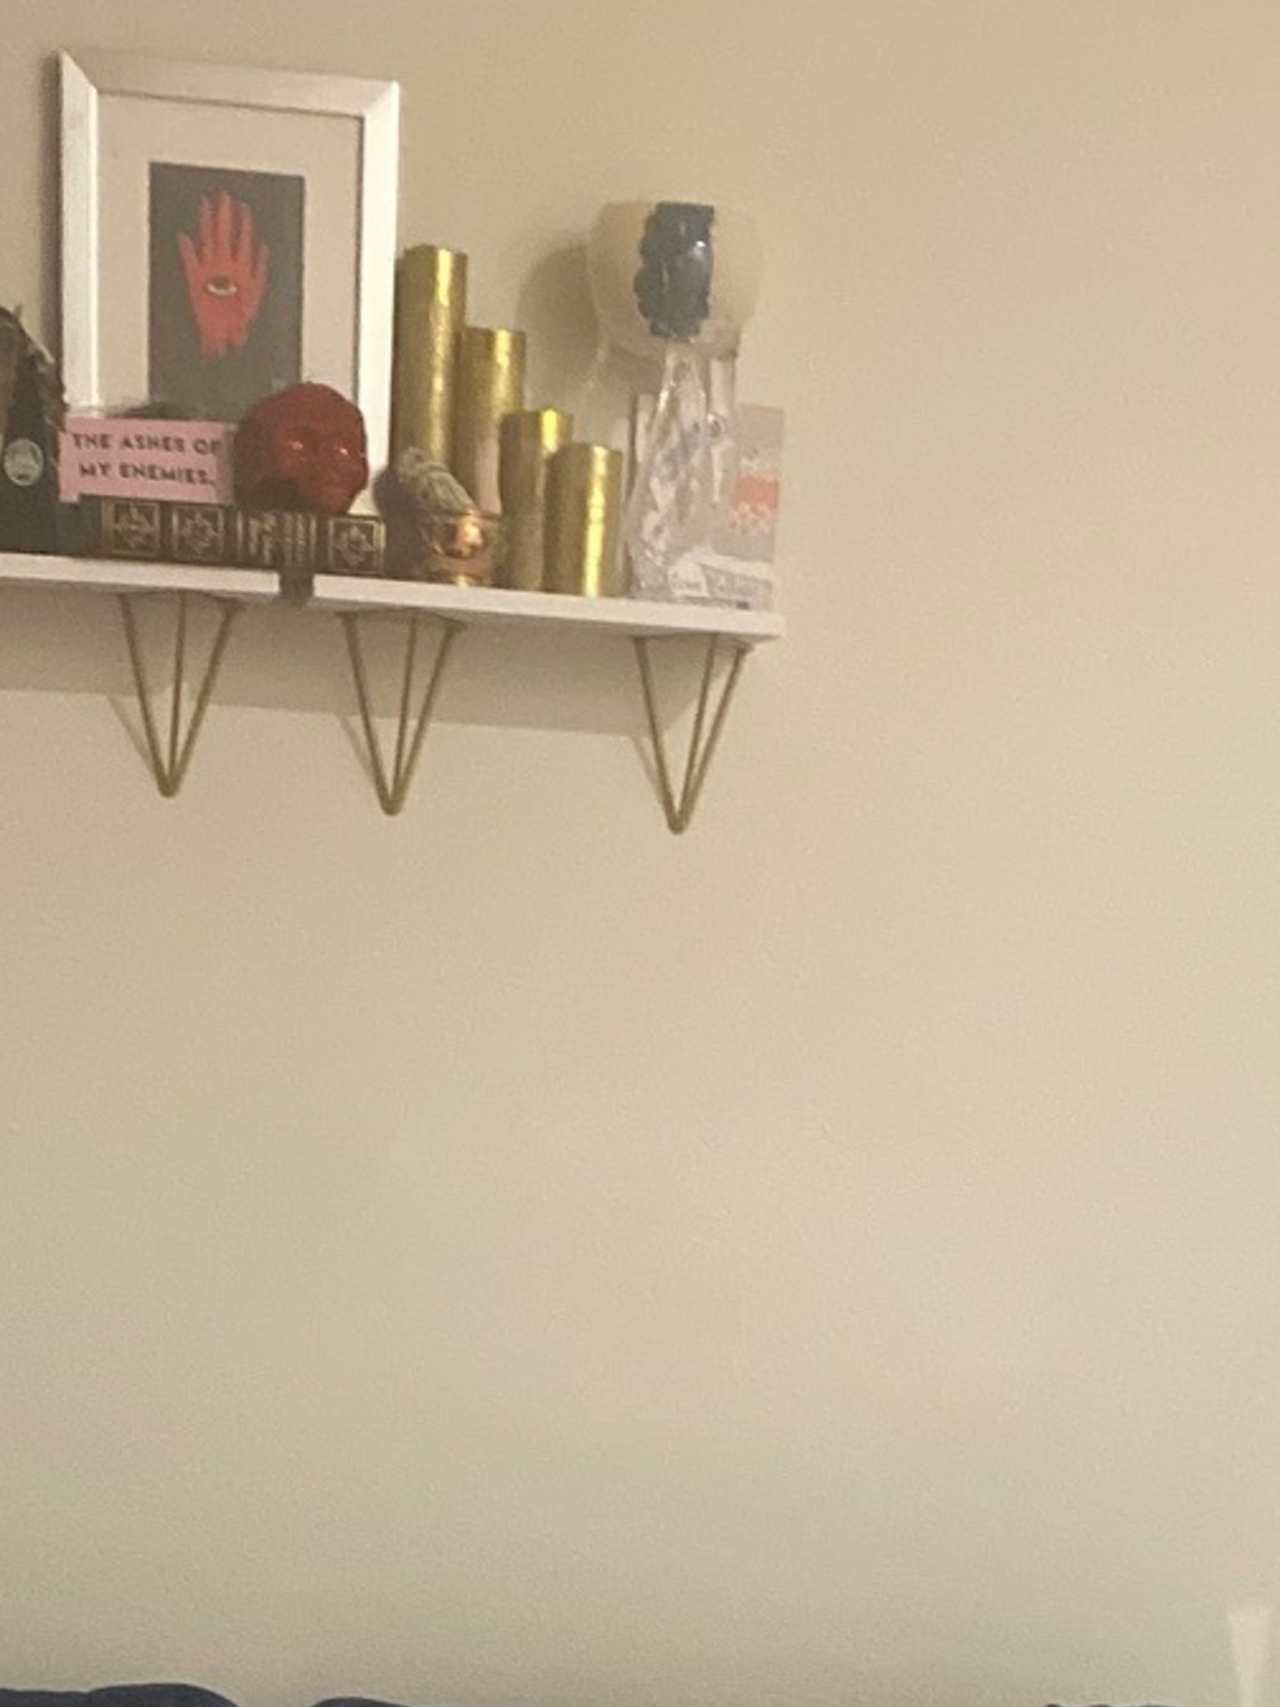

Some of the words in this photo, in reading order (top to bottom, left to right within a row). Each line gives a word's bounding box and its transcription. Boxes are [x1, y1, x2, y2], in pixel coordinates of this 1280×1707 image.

[72, 432, 110, 450] THE
[121, 434, 186, 453] ASHES
[192, 438, 224, 456] OF
[78, 463, 110, 478] MY
